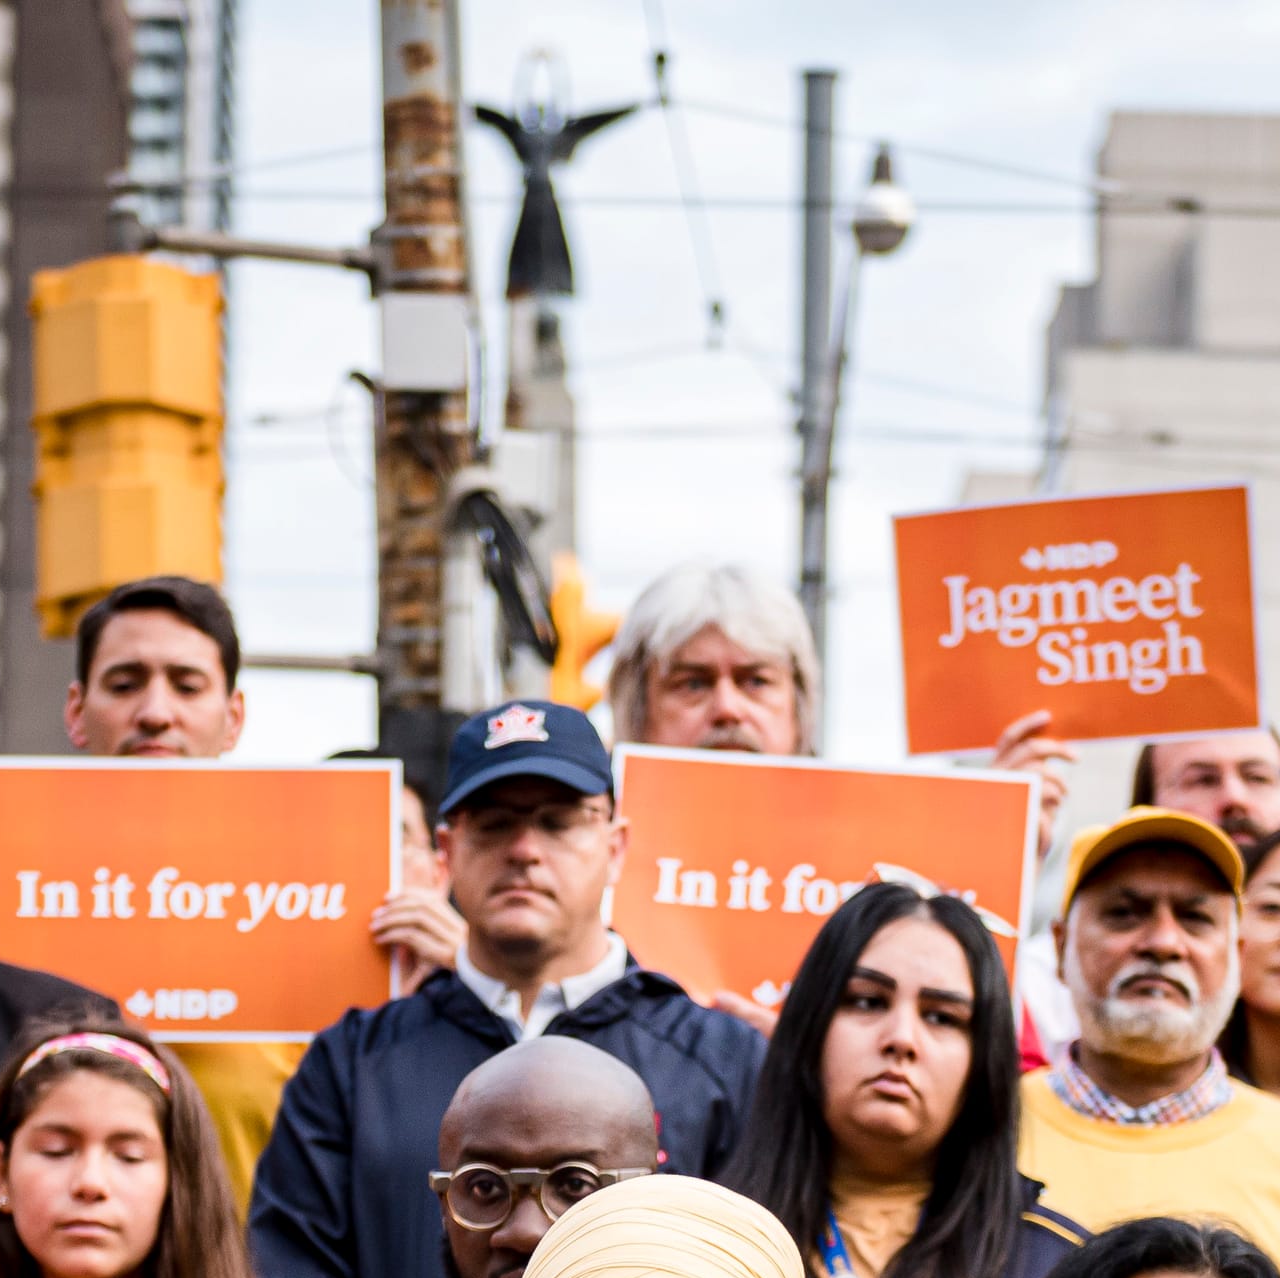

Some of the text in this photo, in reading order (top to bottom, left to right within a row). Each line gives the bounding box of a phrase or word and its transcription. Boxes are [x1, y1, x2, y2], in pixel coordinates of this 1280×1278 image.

[939, 562, 1204, 648] Jagmeet
[1036, 620, 1207, 695] Singh
[15, 866, 348, 933] In it for you
[654, 857, 718, 908] In
[726, 860, 773, 911] it
[154, 989, 239, 1020] NDP
